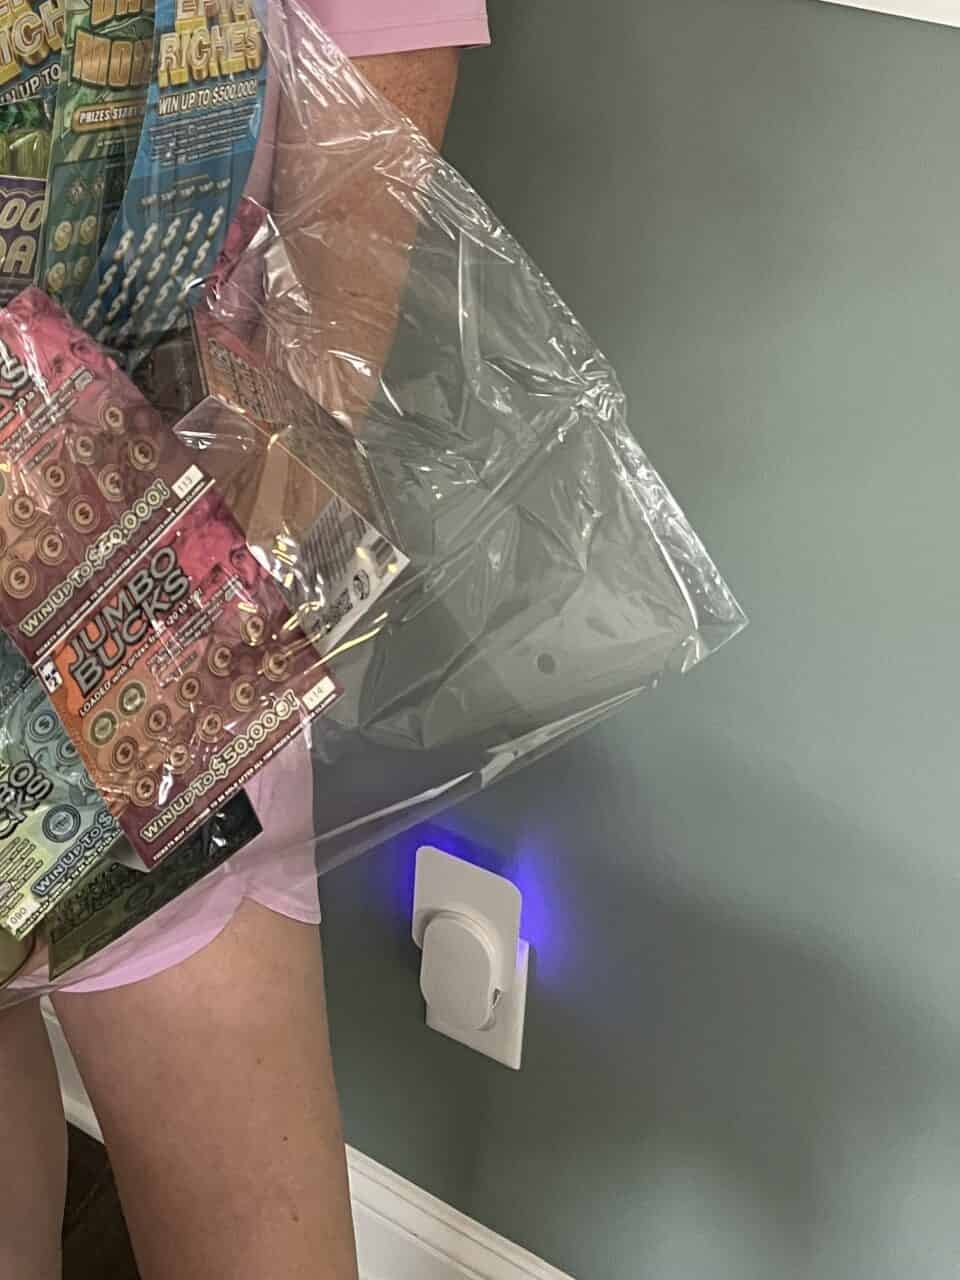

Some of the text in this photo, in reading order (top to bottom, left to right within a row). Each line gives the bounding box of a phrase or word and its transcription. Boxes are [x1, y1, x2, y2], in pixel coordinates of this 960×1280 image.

[19, 76, 39, 96] UP
[40, 64, 62, 85] TO
[159, 21, 263, 88] RICHES
[158, 95, 180, 116] WIN
[181, 91, 195, 109] UP
[197, 90, 209, 106] TO
[22, 604, 54, 633] WIN
[52, 583, 73, 606] UP
[73, 564, 91, 585] TO
[70, 546, 177, 671] JUMBO
[74, 569, 188, 696] BUCKS
[143, 810, 173, 838] WIN
[173, 792, 194, 813] UP
[193, 774, 214, 794] TO
[211, 692, 299, 775] $50,000!
[34, 826, 102, 895] WIN UP TO
